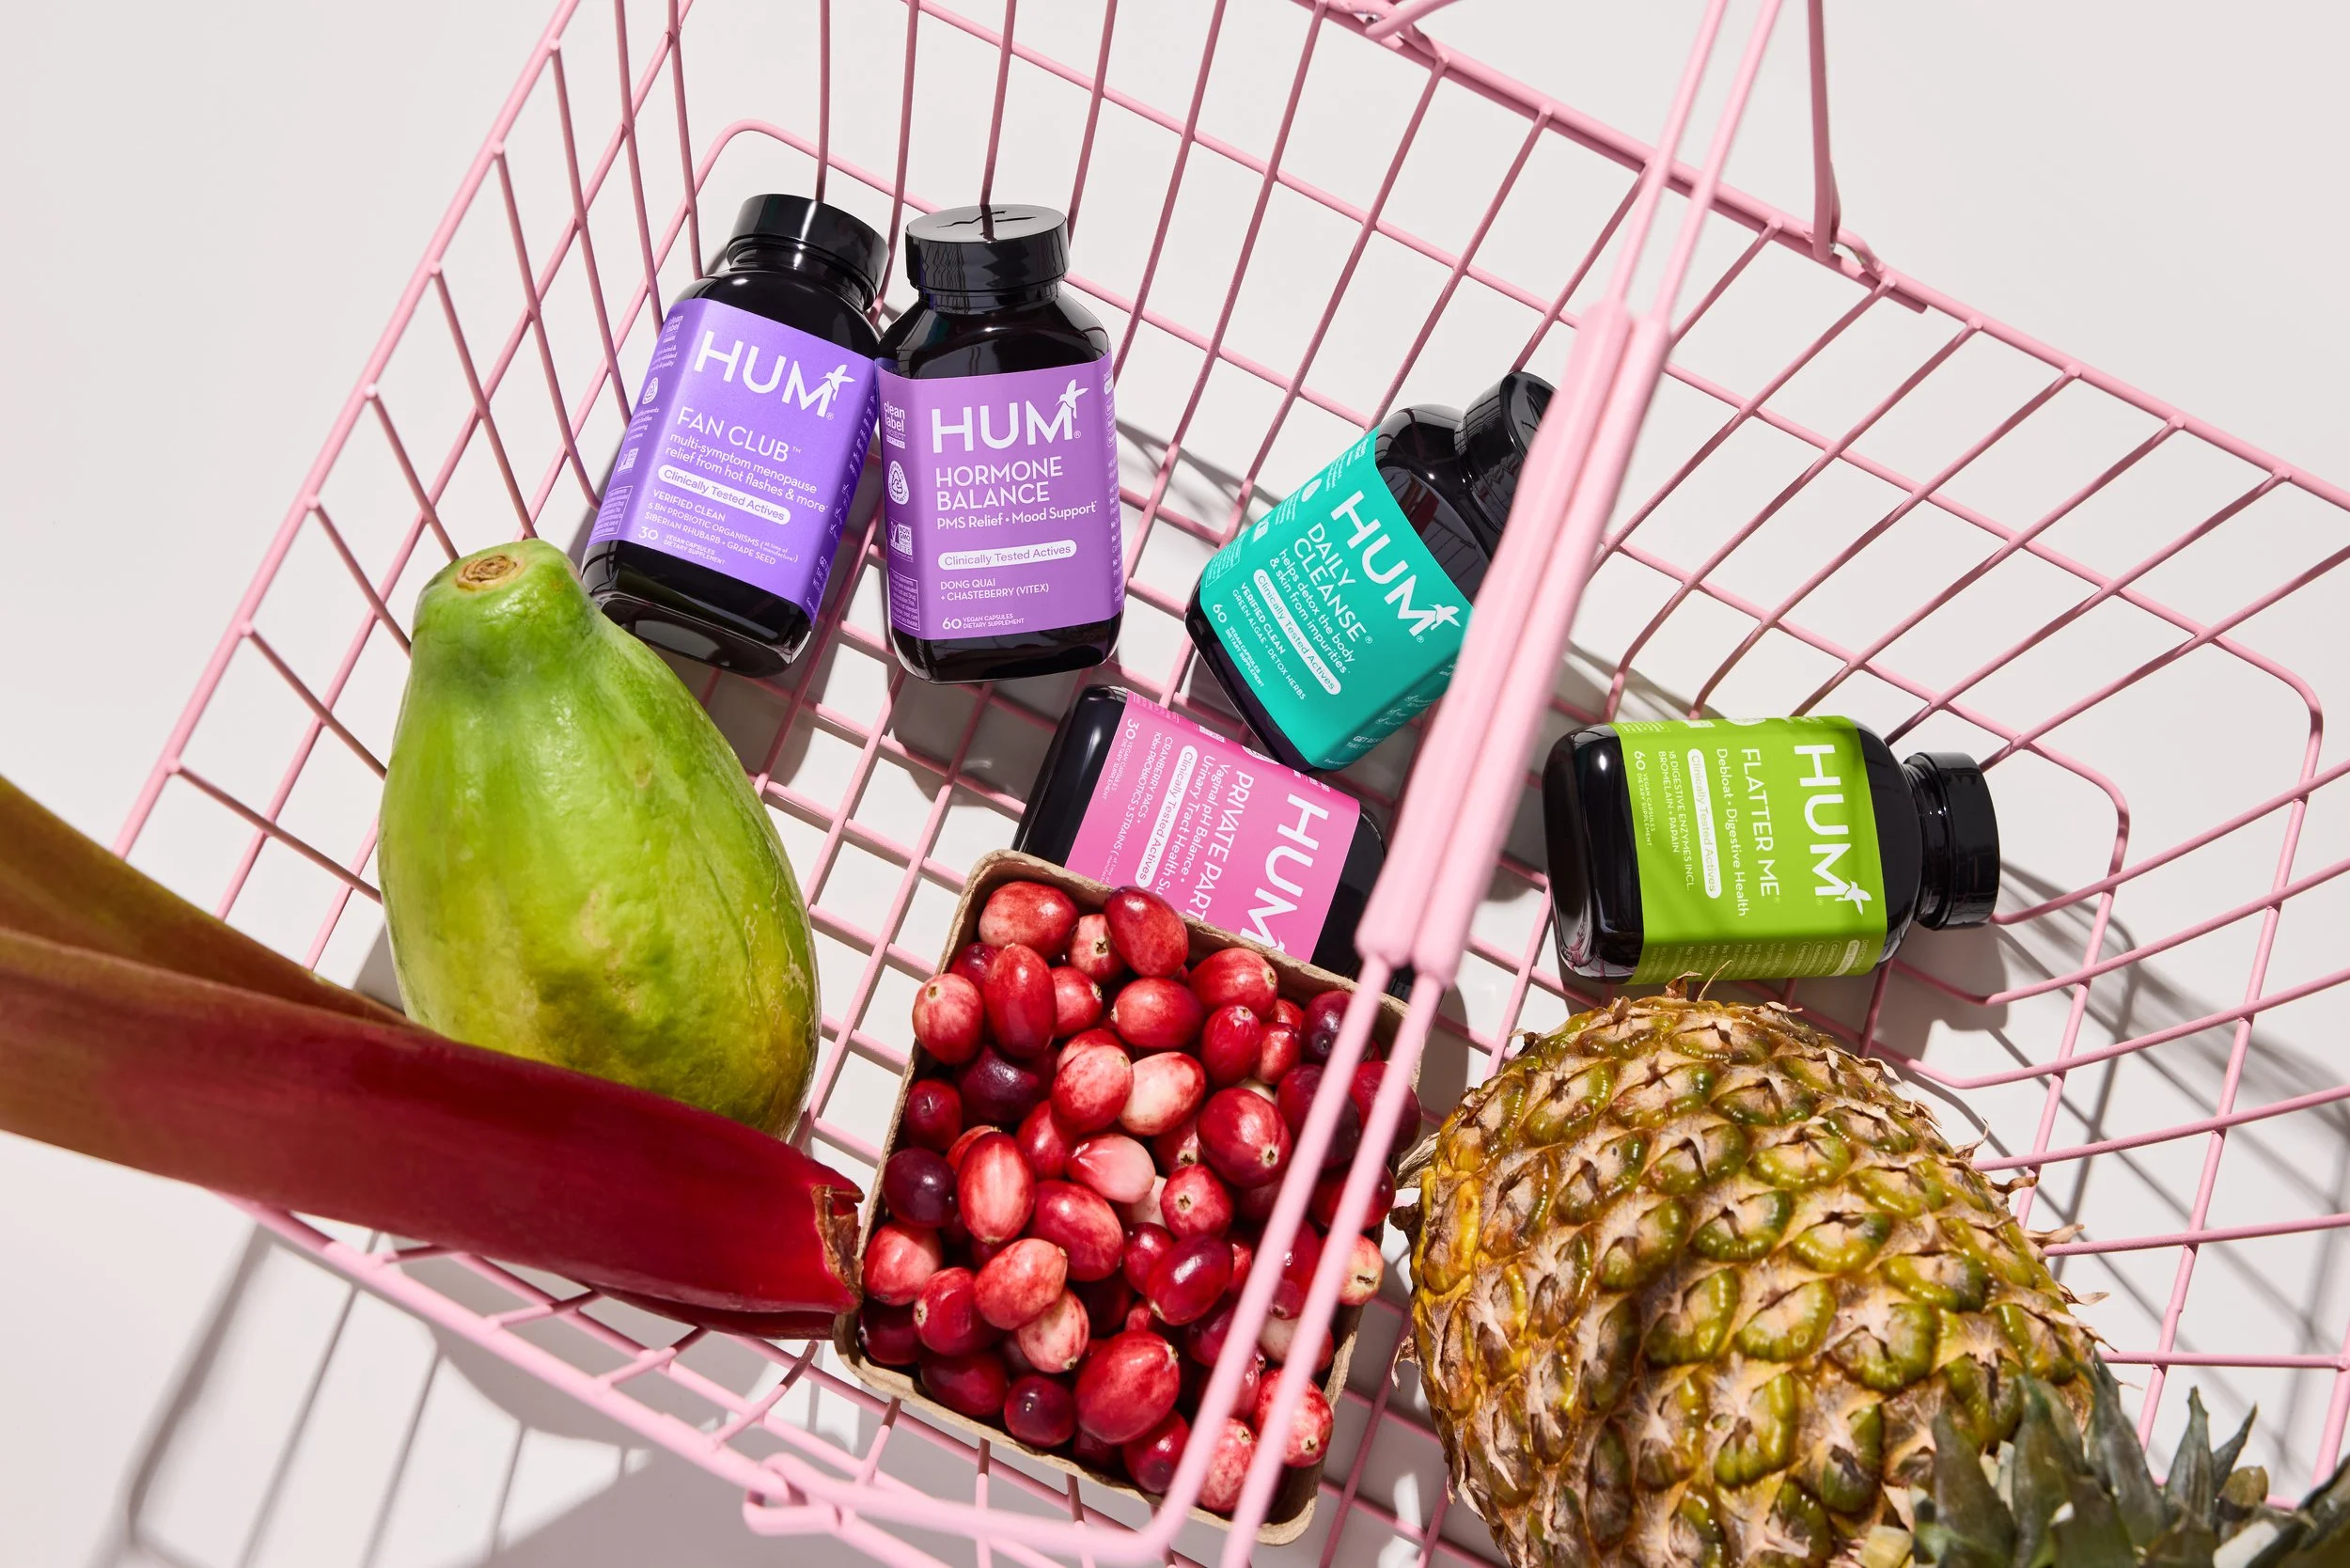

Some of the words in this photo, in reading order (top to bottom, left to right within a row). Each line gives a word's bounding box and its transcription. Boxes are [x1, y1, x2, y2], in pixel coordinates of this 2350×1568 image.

[676, 405, 724, 438] FAN
[884, 400, 905, 419] clean
[885, 415, 904, 431] label
[665, 447, 696, 463] relief
[696, 454, 722, 474] from
[724, 464, 744, 481] hot
[744, 472, 782, 496] flashes
[784, 488, 794, 500] &
[669, 433, 750, 469] multi-symptom
[753, 463, 817, 493] menopause
[935, 455, 1062, 487] HORMONE
[653, 488, 693, 509] VERIFIED
[694, 504, 725, 522] CLEAN
[664, 469, 709, 494] Clinically
[712, 485, 745, 506] Tested
[745, 499, 784, 520] Actives
[936, 480, 1049, 510] BALANCE
[637, 525, 658, 540] 30
[644, 510, 682, 529] SIBERIAN
[682, 525, 720, 543] RHUBARB
[727, 541, 754, 557] GRAPE
[755, 551, 776, 564] SEED
[653, 502, 666, 511] BN
[666, 507, 711, 528] PROBIOTIC
[712, 524, 759, 546] ORGANISMS
[936, 516, 965, 529] PMS
[968, 512, 1002, 527] Relief
[1011, 507, 1046, 524] Mood
[663, 539, 687, 551] DIETARY
[687, 547, 724, 563] SUPPLEMENT
[666, 533, 684, 544] VEGAN
[684, 541, 714, 555] CAPSULES
[944, 554, 992, 565] Clinically
[994, 549, 1029, 561] Tested
[1032, 545, 1071, 557] Actives
[1307, 522, 1355, 586] DAILY
[940, 579, 969, 589] DONG
[971, 577, 996, 588] QUAI
[947, 587, 1013, 601] CHASTEBERRY
[1015, 583, 1048, 595] (VITEX)
[1269, 557, 1279, 569] &
[1276, 570, 1291, 592] skin
[1289, 591, 1308, 620] from
[942, 617, 962, 629] 60
[987, 618, 1024, 626] SUPPLEMENT
[1212, 604, 1227, 622] 60
[1241, 582, 1265, 622] VERIFIED
[1263, 622, 1285, 653] CLEAN
[1276, 548, 1299, 581] helps
[1297, 582, 1320, 615] detox
[1318, 613, 1333, 634] the
[1331, 632, 1355, 662] body
[1232, 589, 1250, 617] GREEN
[1247, 618, 1266, 643] ALGAE
[1267, 648, 1287, 675] DETOX
[1285, 674, 1306, 699] HERBS
[1253, 574, 1285, 619] Clinically
[1285, 619, 1309, 654] Tested
[1307, 655, 1334, 689] Actives
[1116, 738, 1128, 761] DIETARY
[1125, 718, 1139, 739] 30
[1122, 742, 1133, 760] VEGAN
[1148, 736, 1173, 792] CRANBERRY
[1634, 750, 1645, 770] 60
[1102, 761, 1119, 799] SUPPLEMENT
[1111, 760, 1125, 790] CAPSULES
[1130, 750, 1156, 805] PROBIOTICS
[1168, 751, 1193, 797] Clinically
[1189, 755, 1215, 799] Urinary
[1206, 764, 1230, 806] Vaginal
[1669, 760, 1684, 810] DIGESTIVE
[1691, 755, 1705, 804] Clinically
[1716, 748, 1733, 797] Debloat
[1137, 792, 1152, 818] PACS
[1155, 801, 1177, 838] Tested
[1179, 802, 1199, 832] Tract
[1199, 803, 1213, 825] pH
[1207, 770, 1254, 862] PRIVATE
[1637, 773, 1645, 800] DIETARY
[1641, 802, 1652, 845] SUPPLEMENT
[1641, 773, 1651, 795] VEGAN
[1646, 797, 1655, 832] CAPSULES
[1658, 751, 1673, 808] BROMELAIN
[1668, 817, 1679, 852] PAPAIN
[1741, 748, 1773, 851] FLATTER
[1113, 810, 1134, 850] STRAINS
[1678, 813, 1691, 861] ENZYMES
[1700, 806, 1713, 845] Tested
[1724, 808, 1741, 868] Digestive
[1139, 838, 1161, 880] Actives
[1162, 834, 1187, 876] Health
[1181, 825, 1208, 875] Balance
[1704, 848, 1716, 892] Actives
[1185, 861, 1222, 920] PART
[1684, 864, 1694, 890] INCL.
